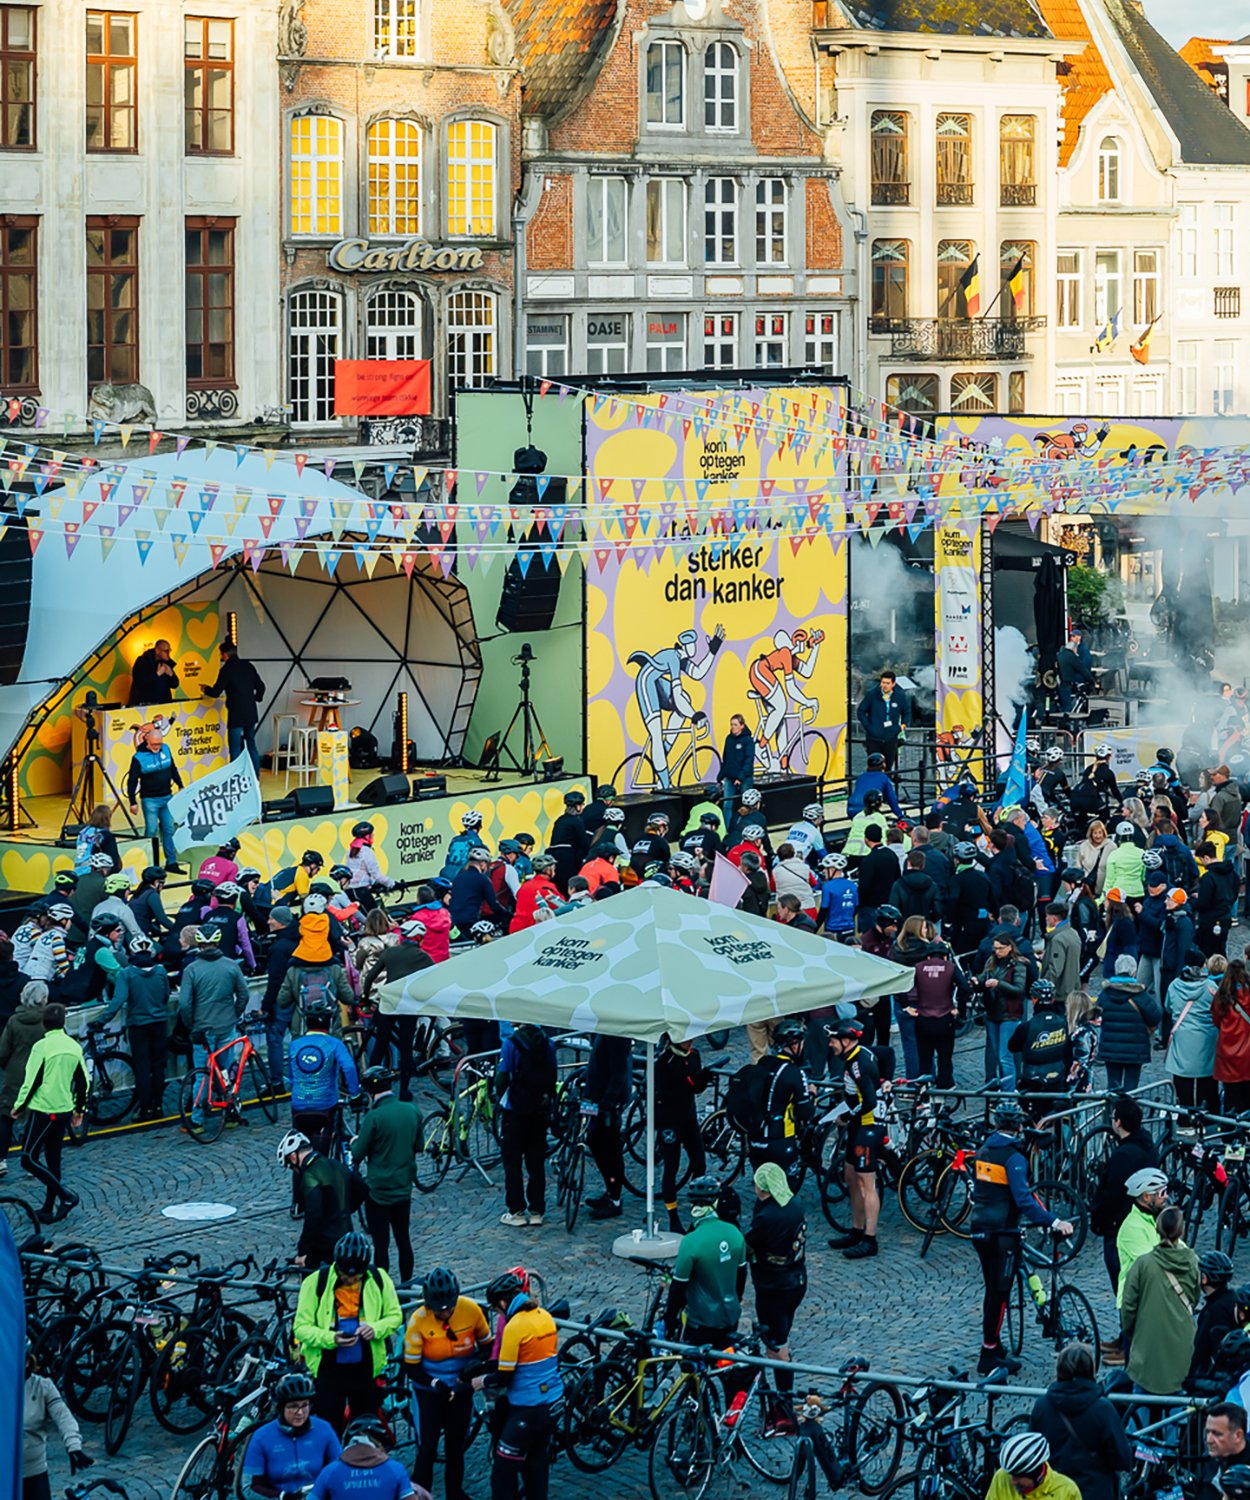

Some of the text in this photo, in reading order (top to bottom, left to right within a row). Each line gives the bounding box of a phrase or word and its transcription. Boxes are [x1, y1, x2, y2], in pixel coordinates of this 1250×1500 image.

[331, 238, 484, 271] Carlton
[527, 324, 563, 336] STAMINET
[587, 321, 622, 335] OASE
[649, 323, 678, 334] PALM
[703, 441, 728, 453] kom
[687, 546, 764, 574] sterker
[664, 573, 785, 604] dan kanker
[176, 722, 221, 738] Trap na trap
[185, 735, 213, 747] sterker
[177, 745, 221, 756] dan kanker
[400, 822, 424, 837] kom
[400, 850, 436, 865] kanker
[555, 936, 590, 948] kom
[704, 933, 740, 946] kom
[532, 957, 585, 970] kanker
[727, 951, 776, 964] kanker
[1031, 1034, 1067, 1049] FLANDERS
